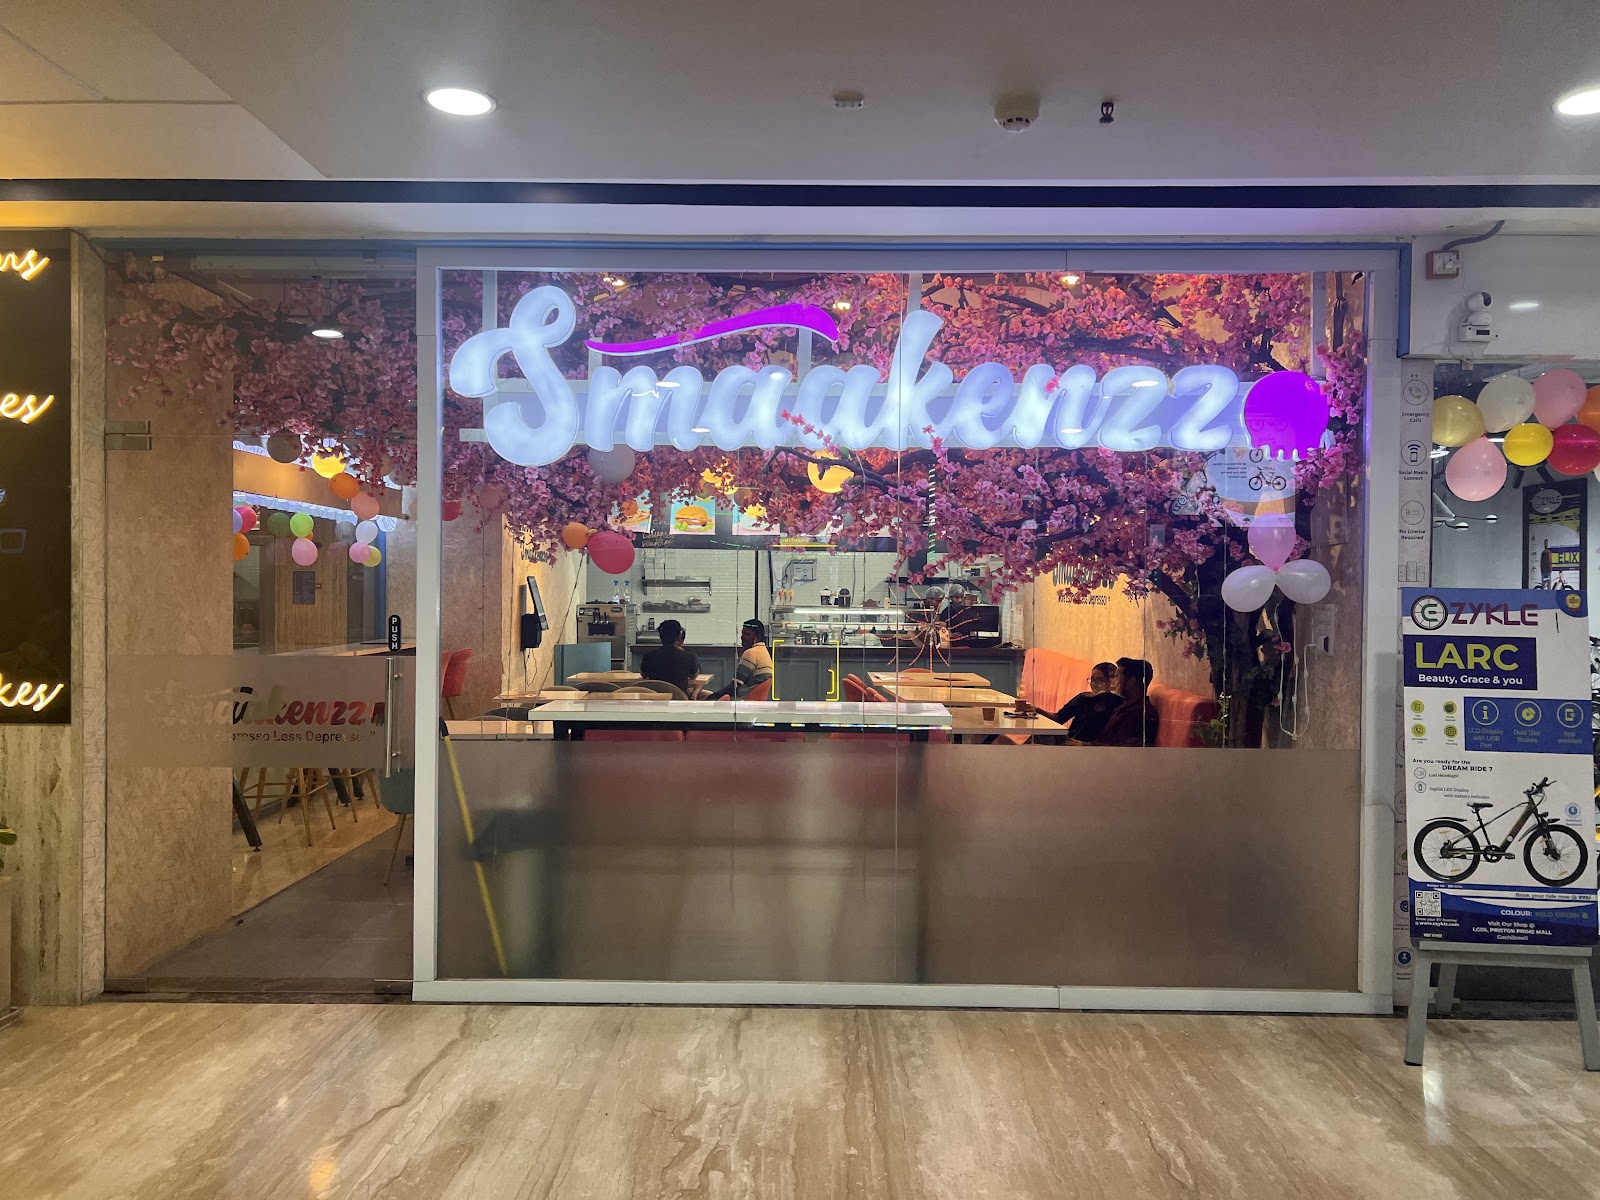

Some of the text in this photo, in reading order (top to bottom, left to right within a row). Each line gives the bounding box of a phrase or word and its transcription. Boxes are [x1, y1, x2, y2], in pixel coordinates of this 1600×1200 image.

[449, 284, 1238, 468] Smaakenzz
[1415, 642, 1519, 671] LARC
[1418, 674, 1523, 686] Beauty, Grace & you
